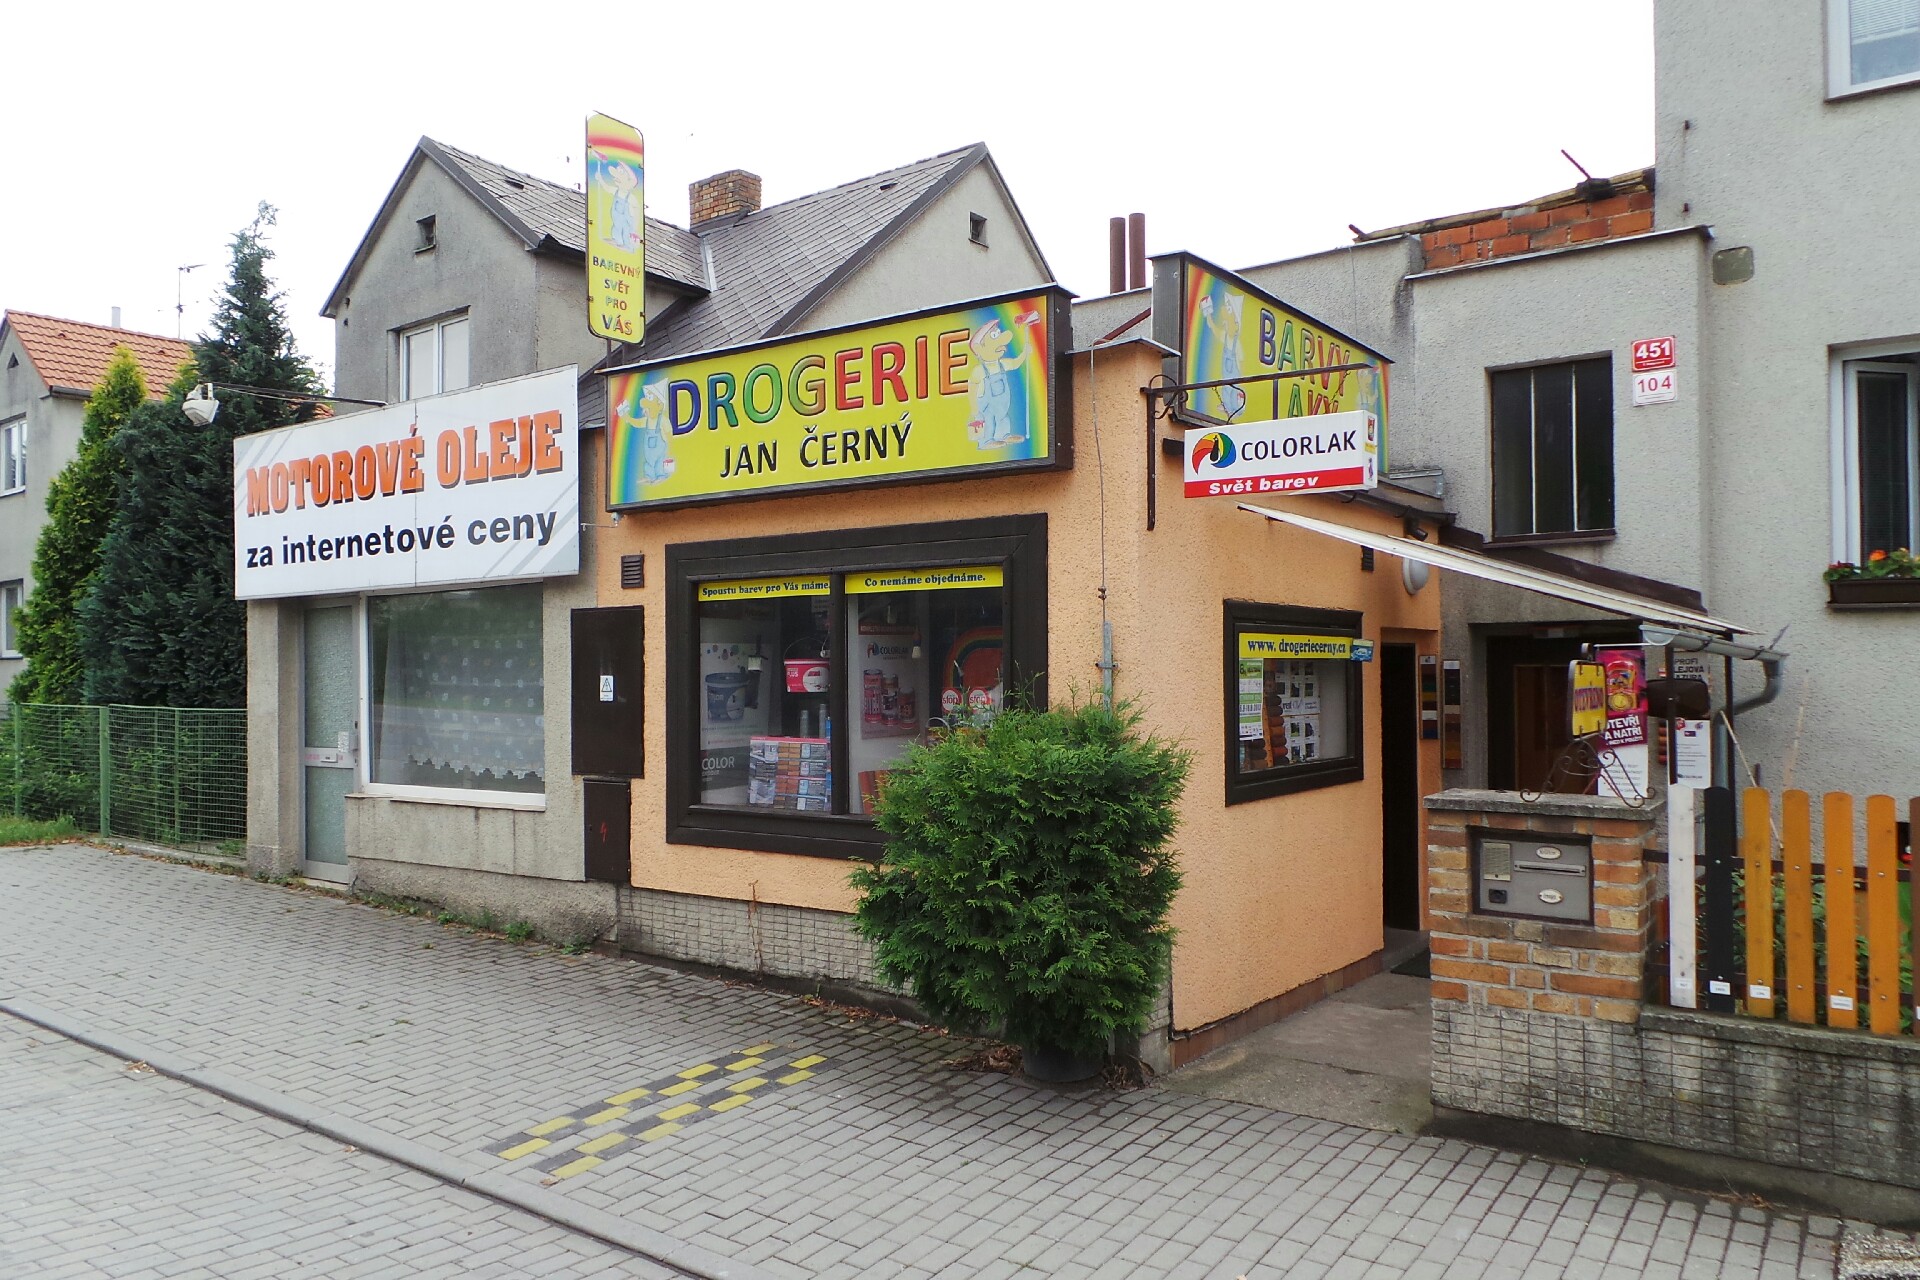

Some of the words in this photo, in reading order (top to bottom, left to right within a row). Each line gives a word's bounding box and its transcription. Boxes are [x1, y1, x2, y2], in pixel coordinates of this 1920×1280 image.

[593, 256, 641, 279] BAREVNÝ
[604, 277, 630, 296] SVĚT
[605, 296, 627, 311] PRO
[602, 313, 633, 336] VÁS
[1259, 307, 1350, 397] BARVY
[1636, 340, 1671, 359] 451
[669, 328, 971, 436] DROGERIE
[1637, 375, 1672, 393] 104
[720, 440, 778, 478] JAN
[799, 410, 913, 468] ČERNÝ
[1241, 430, 1357, 461] COLORLAK
[246, 424, 425, 518] MOTOROVÉ
[437, 409, 563, 488] OLEJE
[1209, 479, 1252, 495] Svět
[1259, 475, 1319, 491] barev
[247, 543, 273, 568] za
[282, 514, 455, 565] internetové
[467, 510, 557, 546] ceny
[702, 586, 737, 598] Spoustu
[739, 585, 763, 594] barev
[766, 584, 781, 594] pro
[783, 582, 798, 591] Vás
[801, 580, 831, 590] máme.
[864, 578, 877, 587] Co
[880, 575, 922, 586] nemáme
[925, 573, 986, 585] objednáme.
[1247, 641, 1276, 653] www.
[1604, 731, 1612, 740] A
